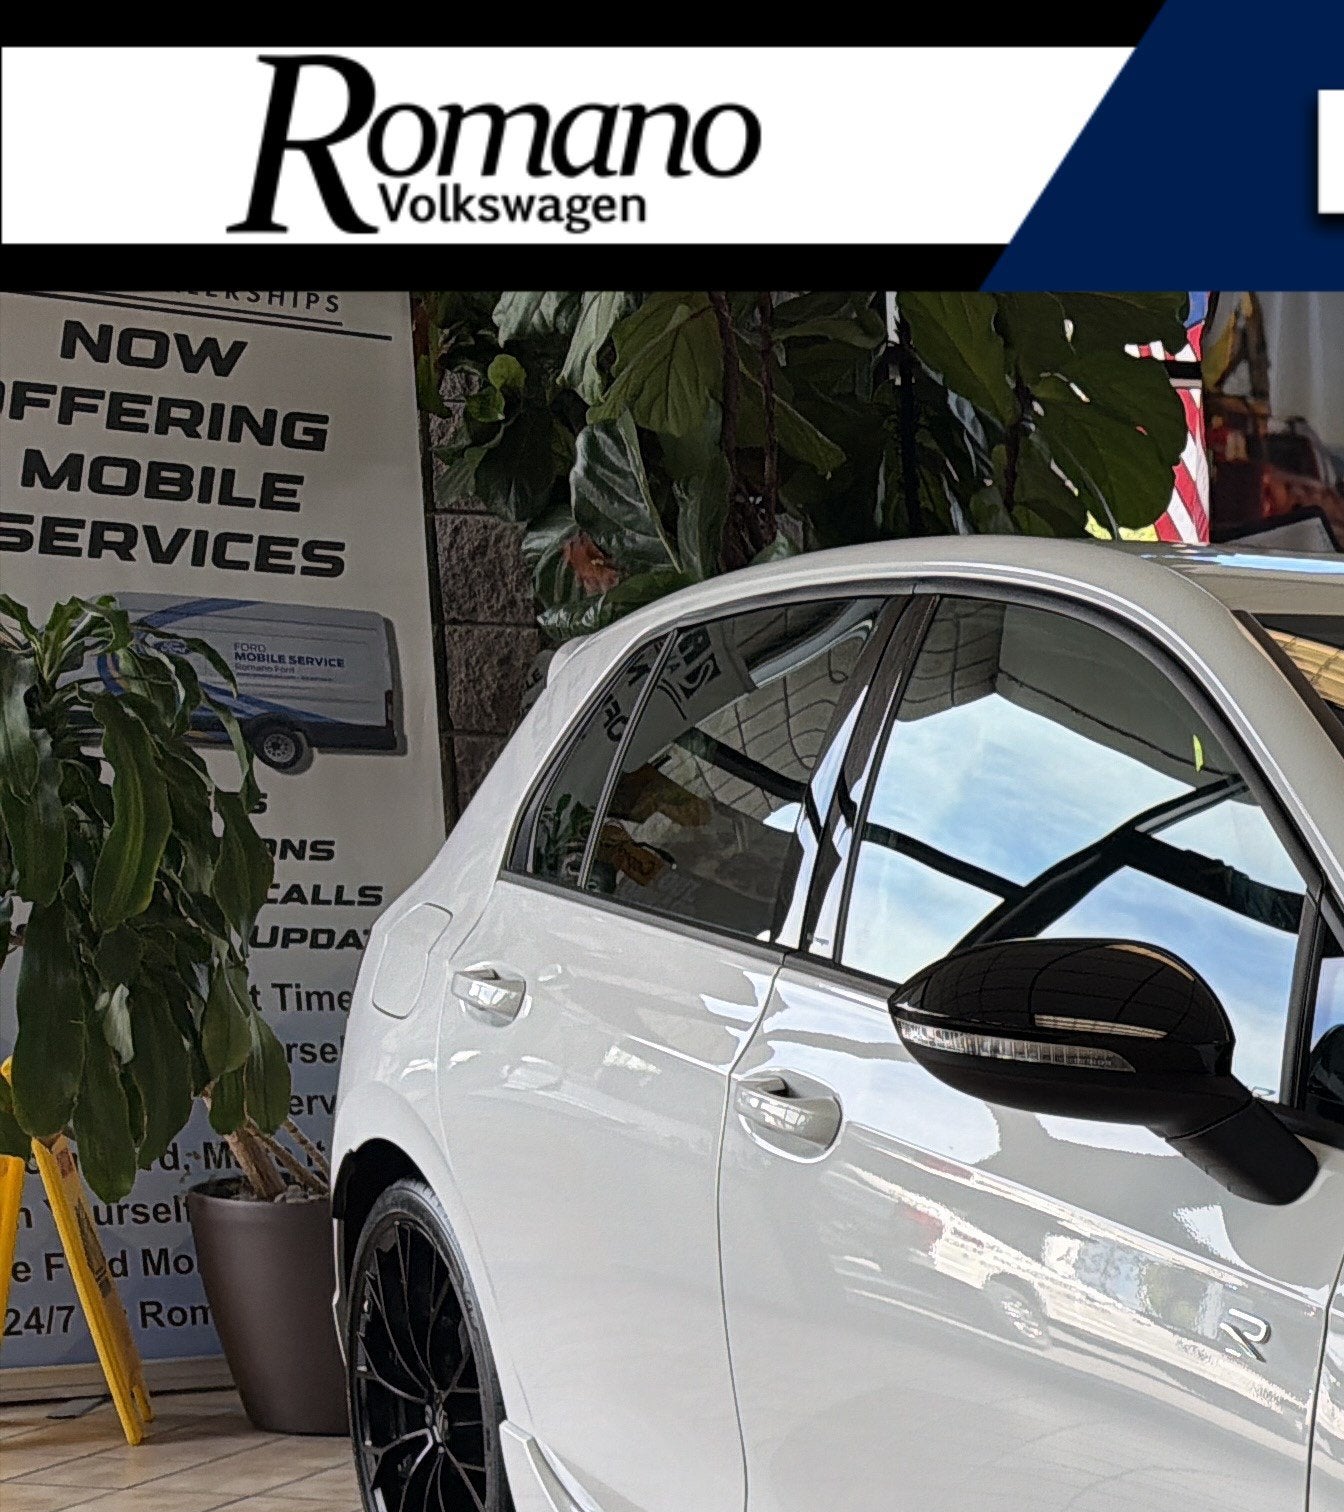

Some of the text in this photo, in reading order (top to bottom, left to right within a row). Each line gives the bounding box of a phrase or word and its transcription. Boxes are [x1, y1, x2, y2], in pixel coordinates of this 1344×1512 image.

[60, 319, 249, 378] NOW
[0, 380, 330, 453] FFERING
[20, 448, 305, 513] MOBILE
[233, 642, 267, 653] FORD
[234, 652, 346, 668] MOBILE SERVICE
[265, 883, 384, 907] CALLS
[250, 925, 372, 950] UPDA
[4, 1305, 75, 1336] 24/7
